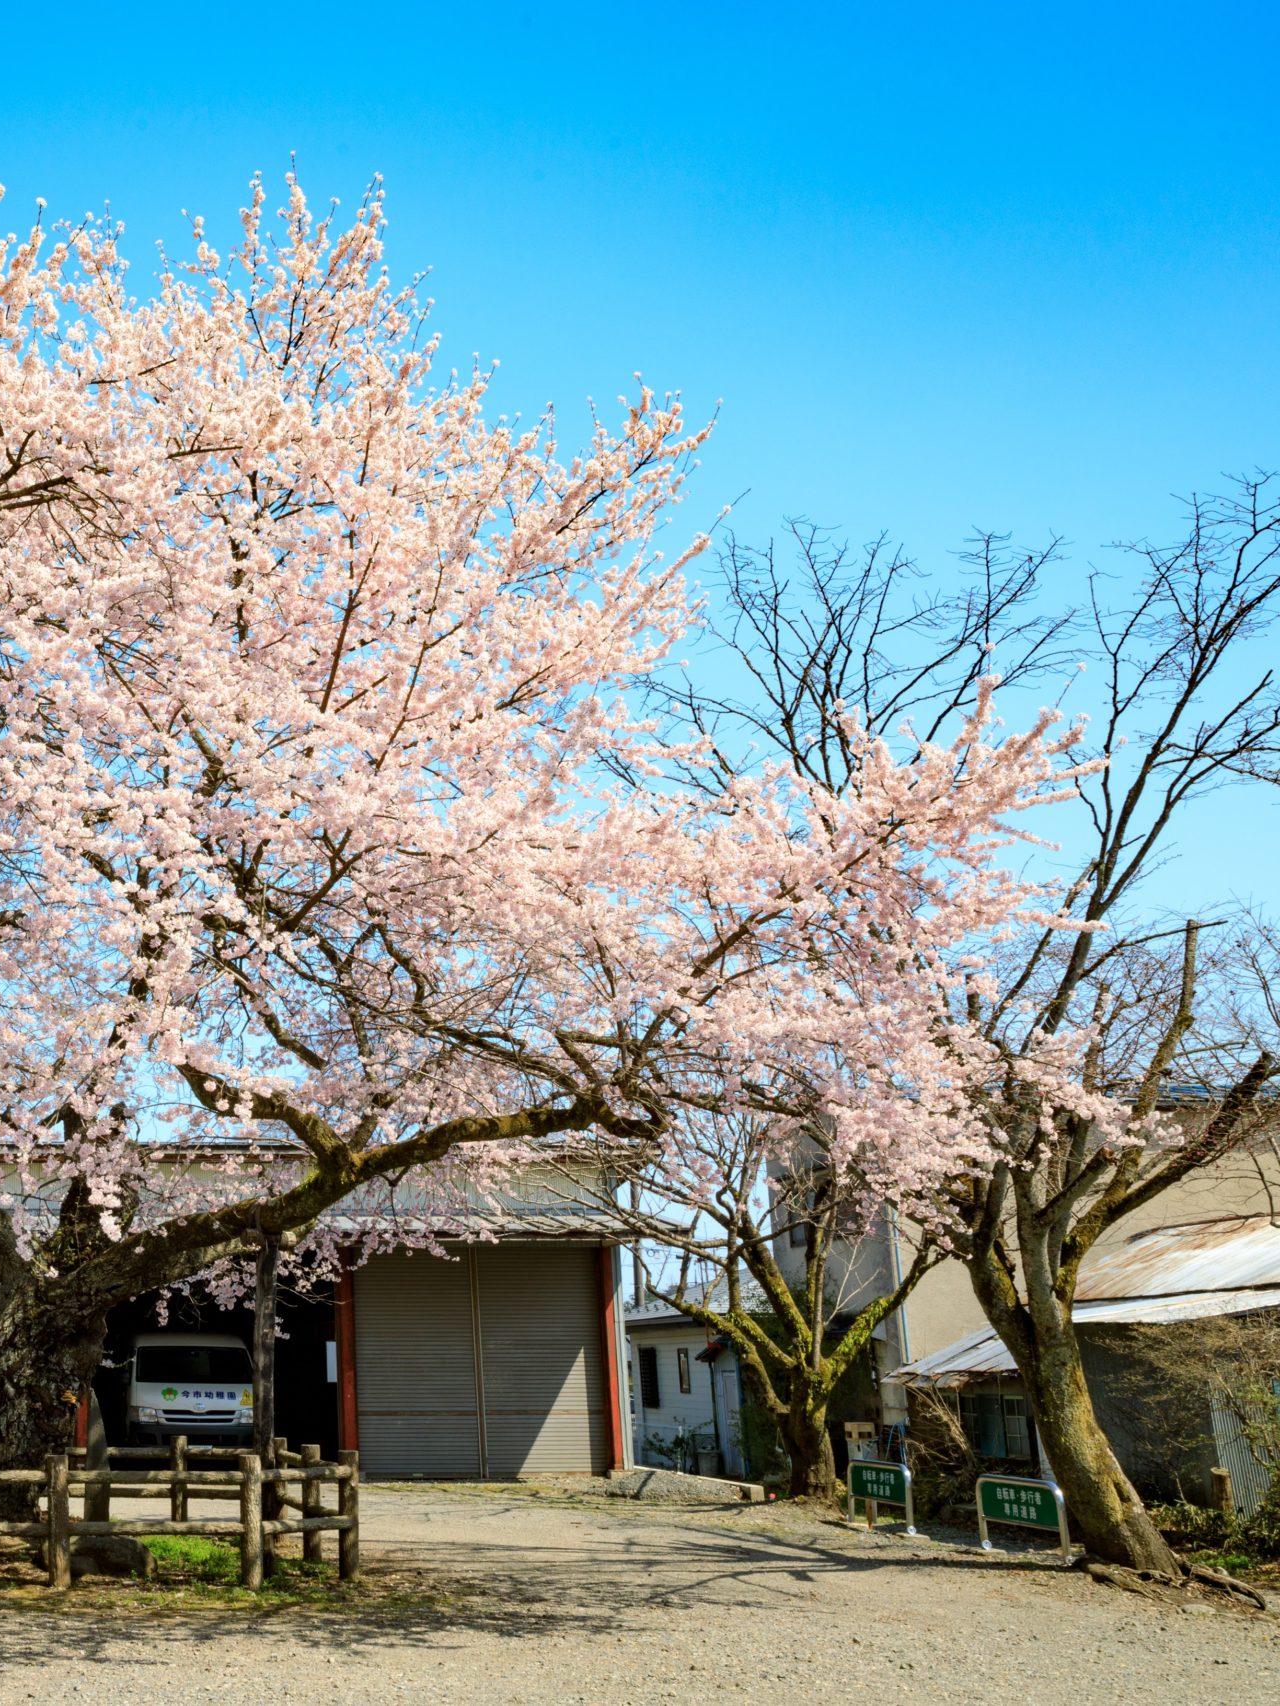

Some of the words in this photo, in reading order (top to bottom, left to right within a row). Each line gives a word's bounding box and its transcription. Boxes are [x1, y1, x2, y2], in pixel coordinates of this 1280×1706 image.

[181, 1390, 237, 1400] 今市幼稚園
